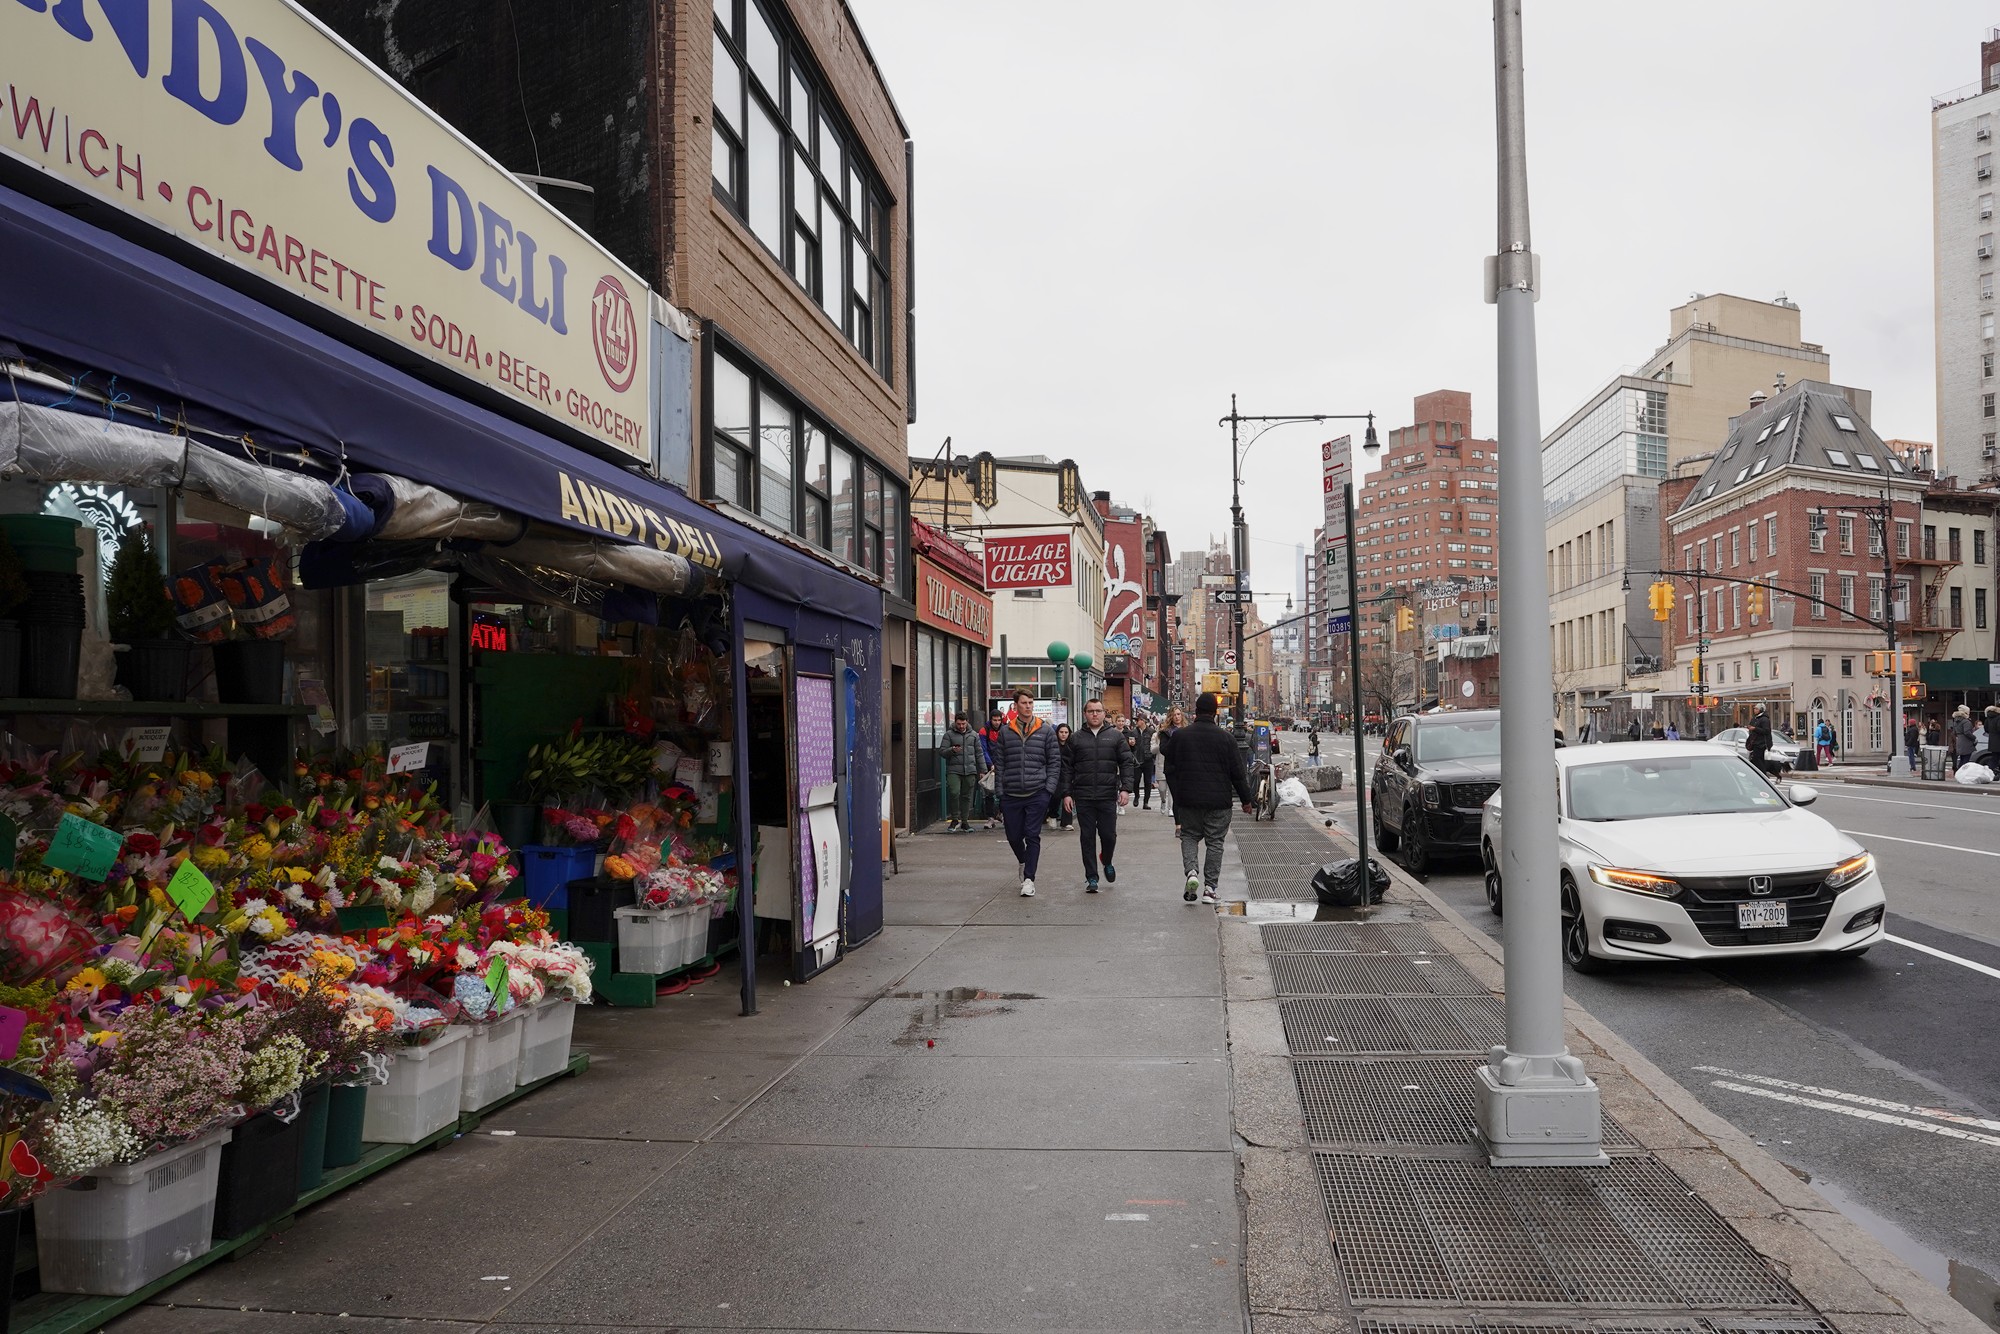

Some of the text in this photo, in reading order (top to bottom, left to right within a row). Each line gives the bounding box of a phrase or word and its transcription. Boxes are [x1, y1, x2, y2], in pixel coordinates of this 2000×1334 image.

[426, 165, 569, 335] DELI
[187, 185, 386, 320] CIGARETTE
[410, 304, 480, 369] SODA
[498, 350, 551, 405] BEER
[566, 388, 642, 449] GROCERY
[604, 289, 626, 348] 24
[1325, 478, 1332, 492] 2
[1326, 493, 1345, 503] COMMERCIA
[558, 471, 722, 570] ANDY'S DELI
[988, 543, 1067, 562] VILLAGE
[1328, 550, 1335, 564] 2
[991, 561, 1067, 584] CIGARS
[926, 575, 989, 641] VILLAGE CIGARS
[470, 623, 507, 651] ATM
[1329, 621, 1351, 633] 103819
[1260, 727, 1267, 736] P
[176, 871, 212, 904] $25
[1740, 907, 1785, 922] KRV 2809
